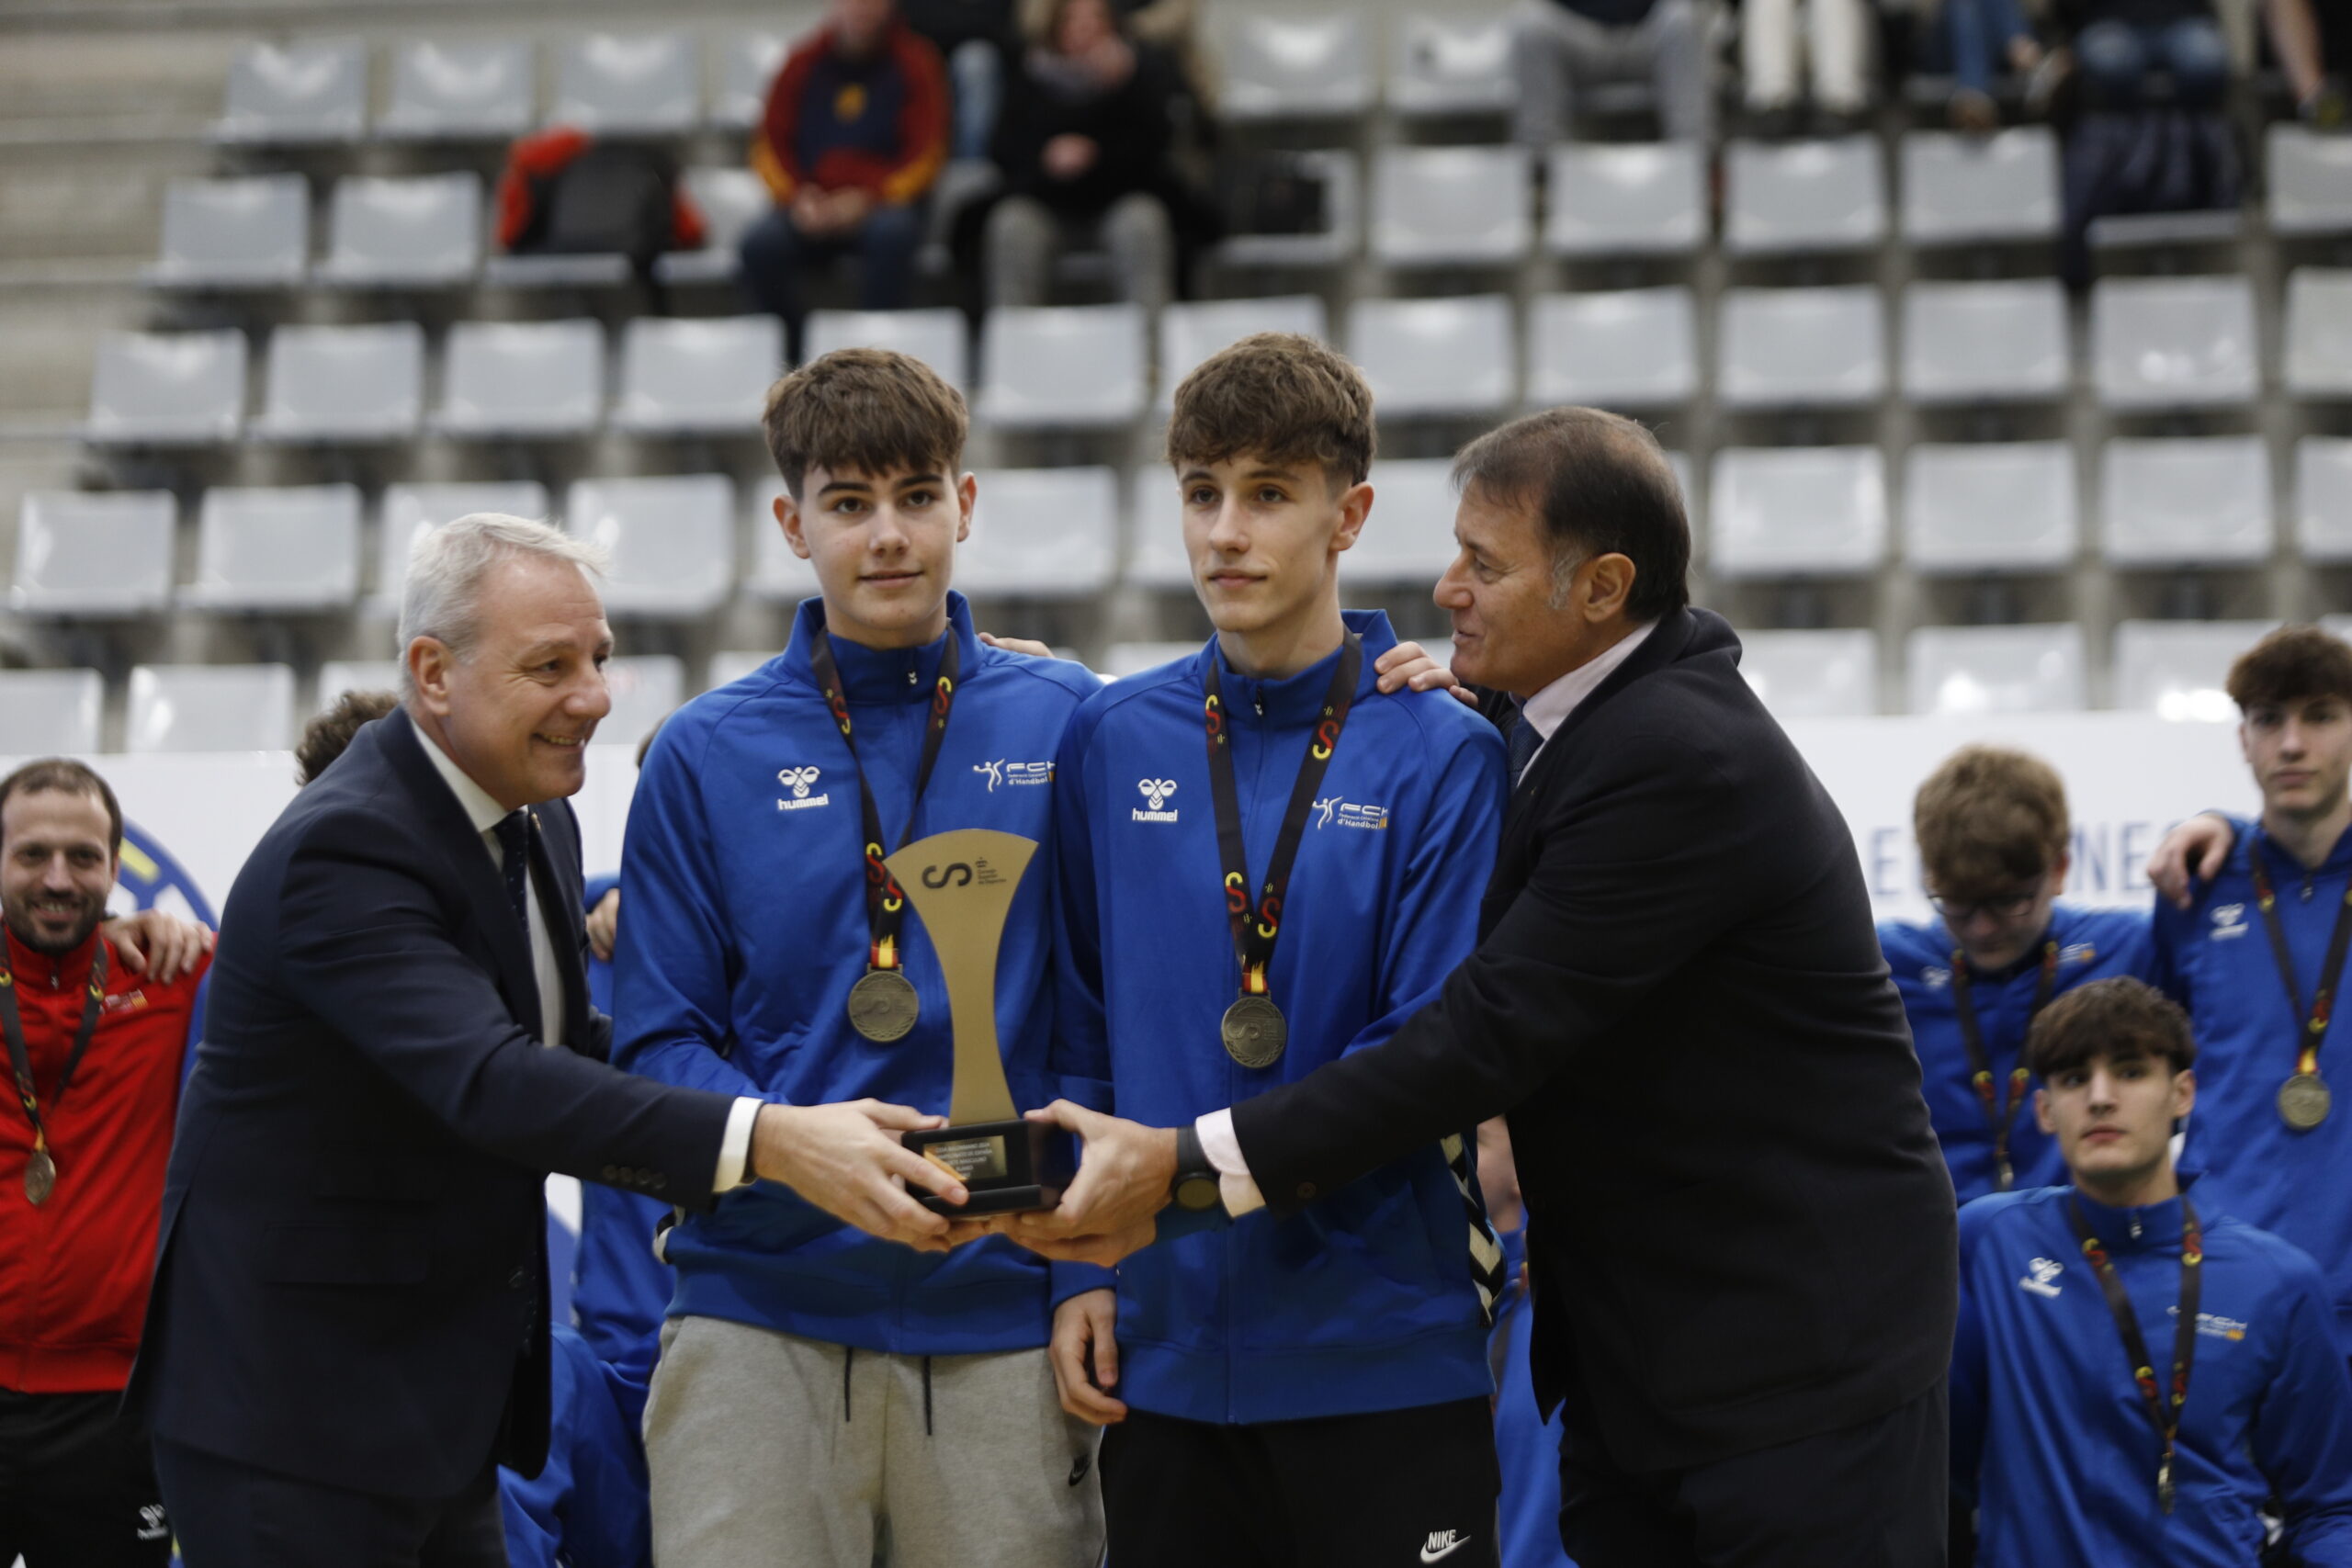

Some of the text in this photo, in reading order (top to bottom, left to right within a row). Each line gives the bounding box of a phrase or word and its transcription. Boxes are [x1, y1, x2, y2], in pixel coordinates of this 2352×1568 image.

[777, 794, 829, 810] hummel
[1132, 807, 1178, 822] hummel
[1338, 818, 1378, 829] d'Handbol
[1428, 1529, 1456, 1550] NIKE
